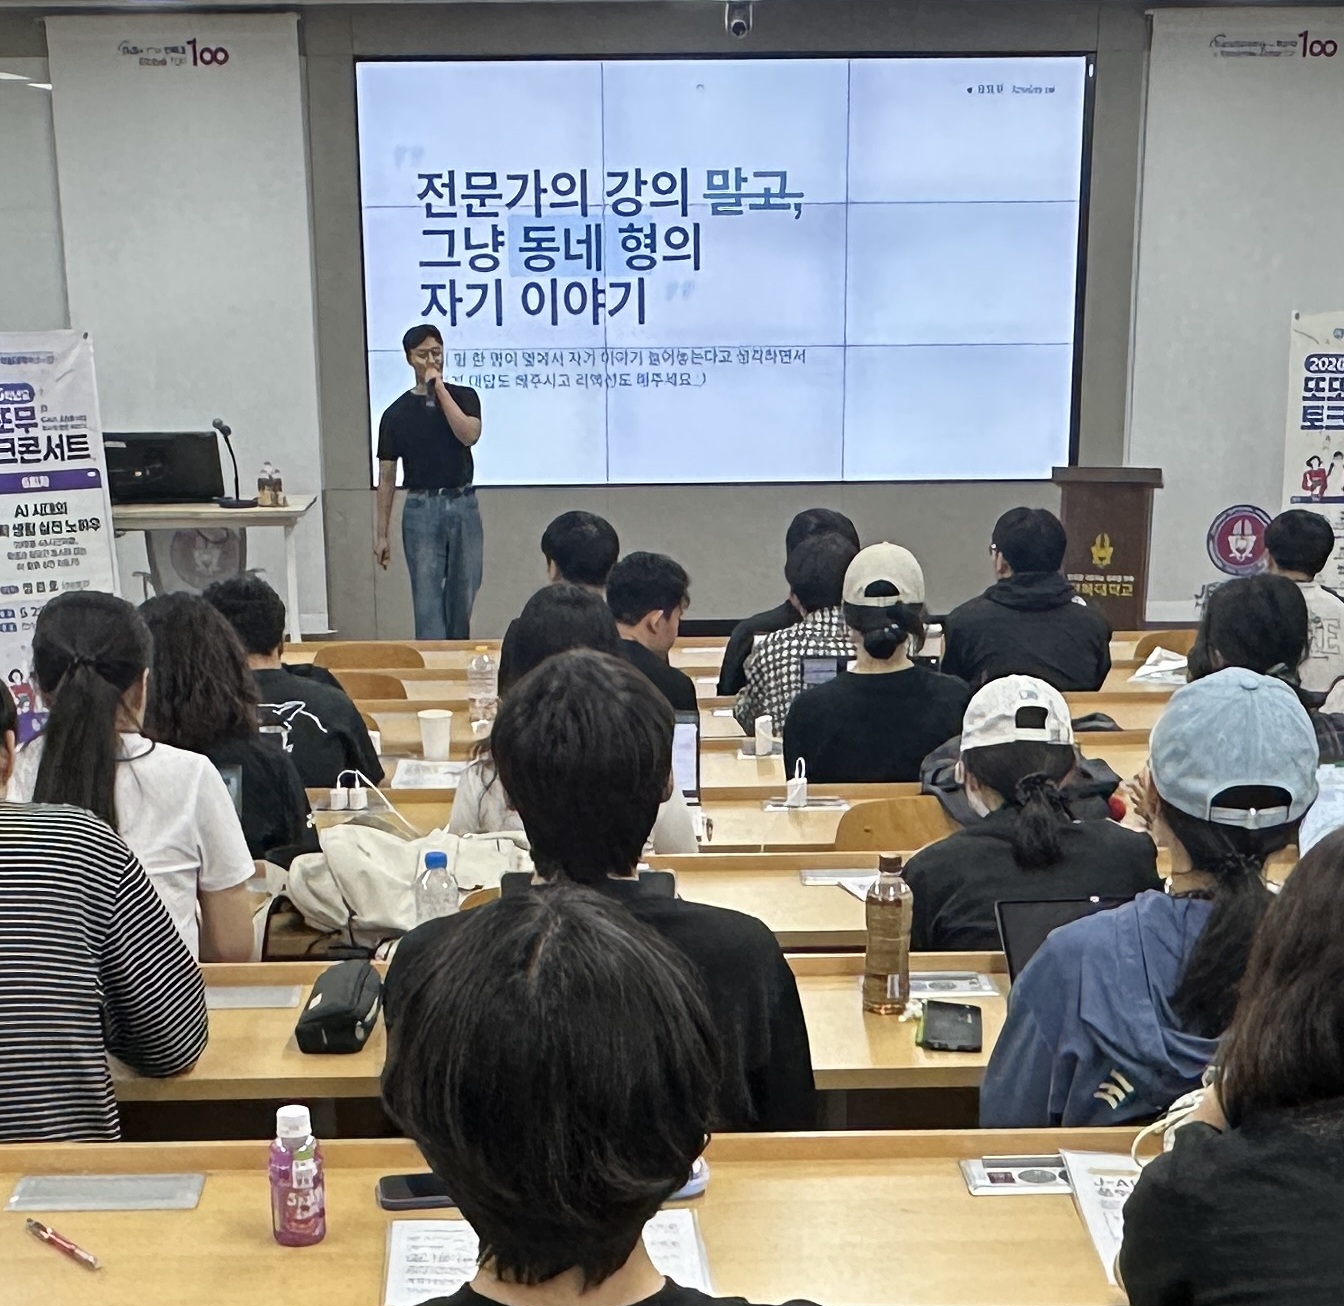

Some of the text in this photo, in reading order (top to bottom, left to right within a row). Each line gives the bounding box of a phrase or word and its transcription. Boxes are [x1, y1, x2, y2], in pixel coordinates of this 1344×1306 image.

[186, 37, 229, 67] 100
[1298, 30, 1338, 58] 100
[416, 166, 805, 220] 전문가의 강의 말고,
[418, 222, 701, 273] 그냥 동네 형의
[420, 276, 646, 327] 자기 이야기
